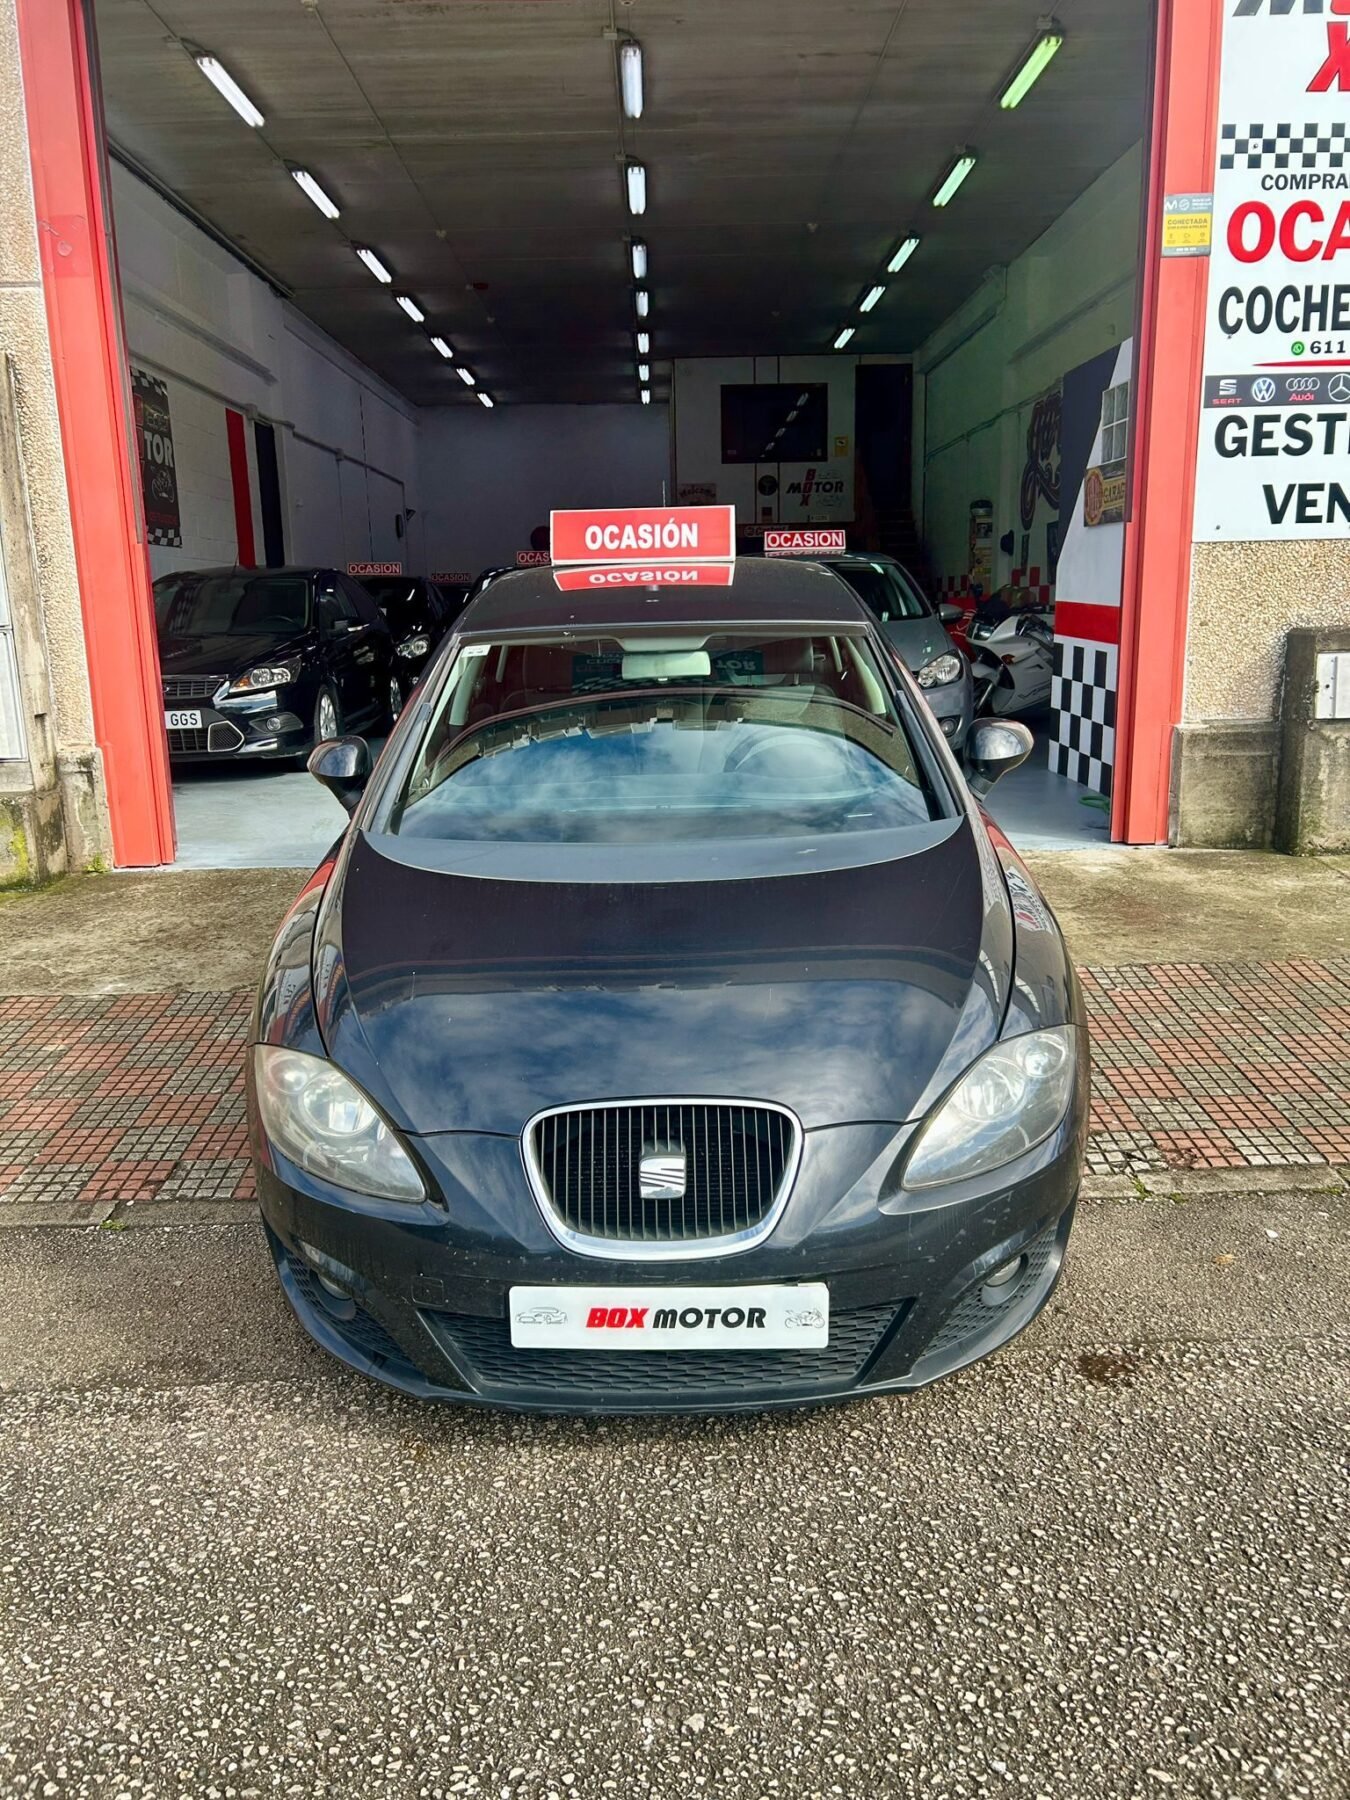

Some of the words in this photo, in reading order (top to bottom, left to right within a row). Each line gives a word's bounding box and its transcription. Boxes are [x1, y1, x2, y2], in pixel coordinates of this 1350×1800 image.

[1261, 173, 1350, 191] COMPRA
[1167, 217, 1208, 226] CONECTADA
[1310, 340, 1346, 354] 611
[1289, 393, 1315, 401] Audi
[1214, 412, 1350, 459] GEST
[585, 517, 698, 550] OCASIÓN
[768, 532, 843, 547] OCASION
[350, 562, 400, 574] OCASION
[170, 712, 198, 727] GGS
[586, 1307, 650, 1328] BOX
[652, 1307, 767, 1329] MOTOR
